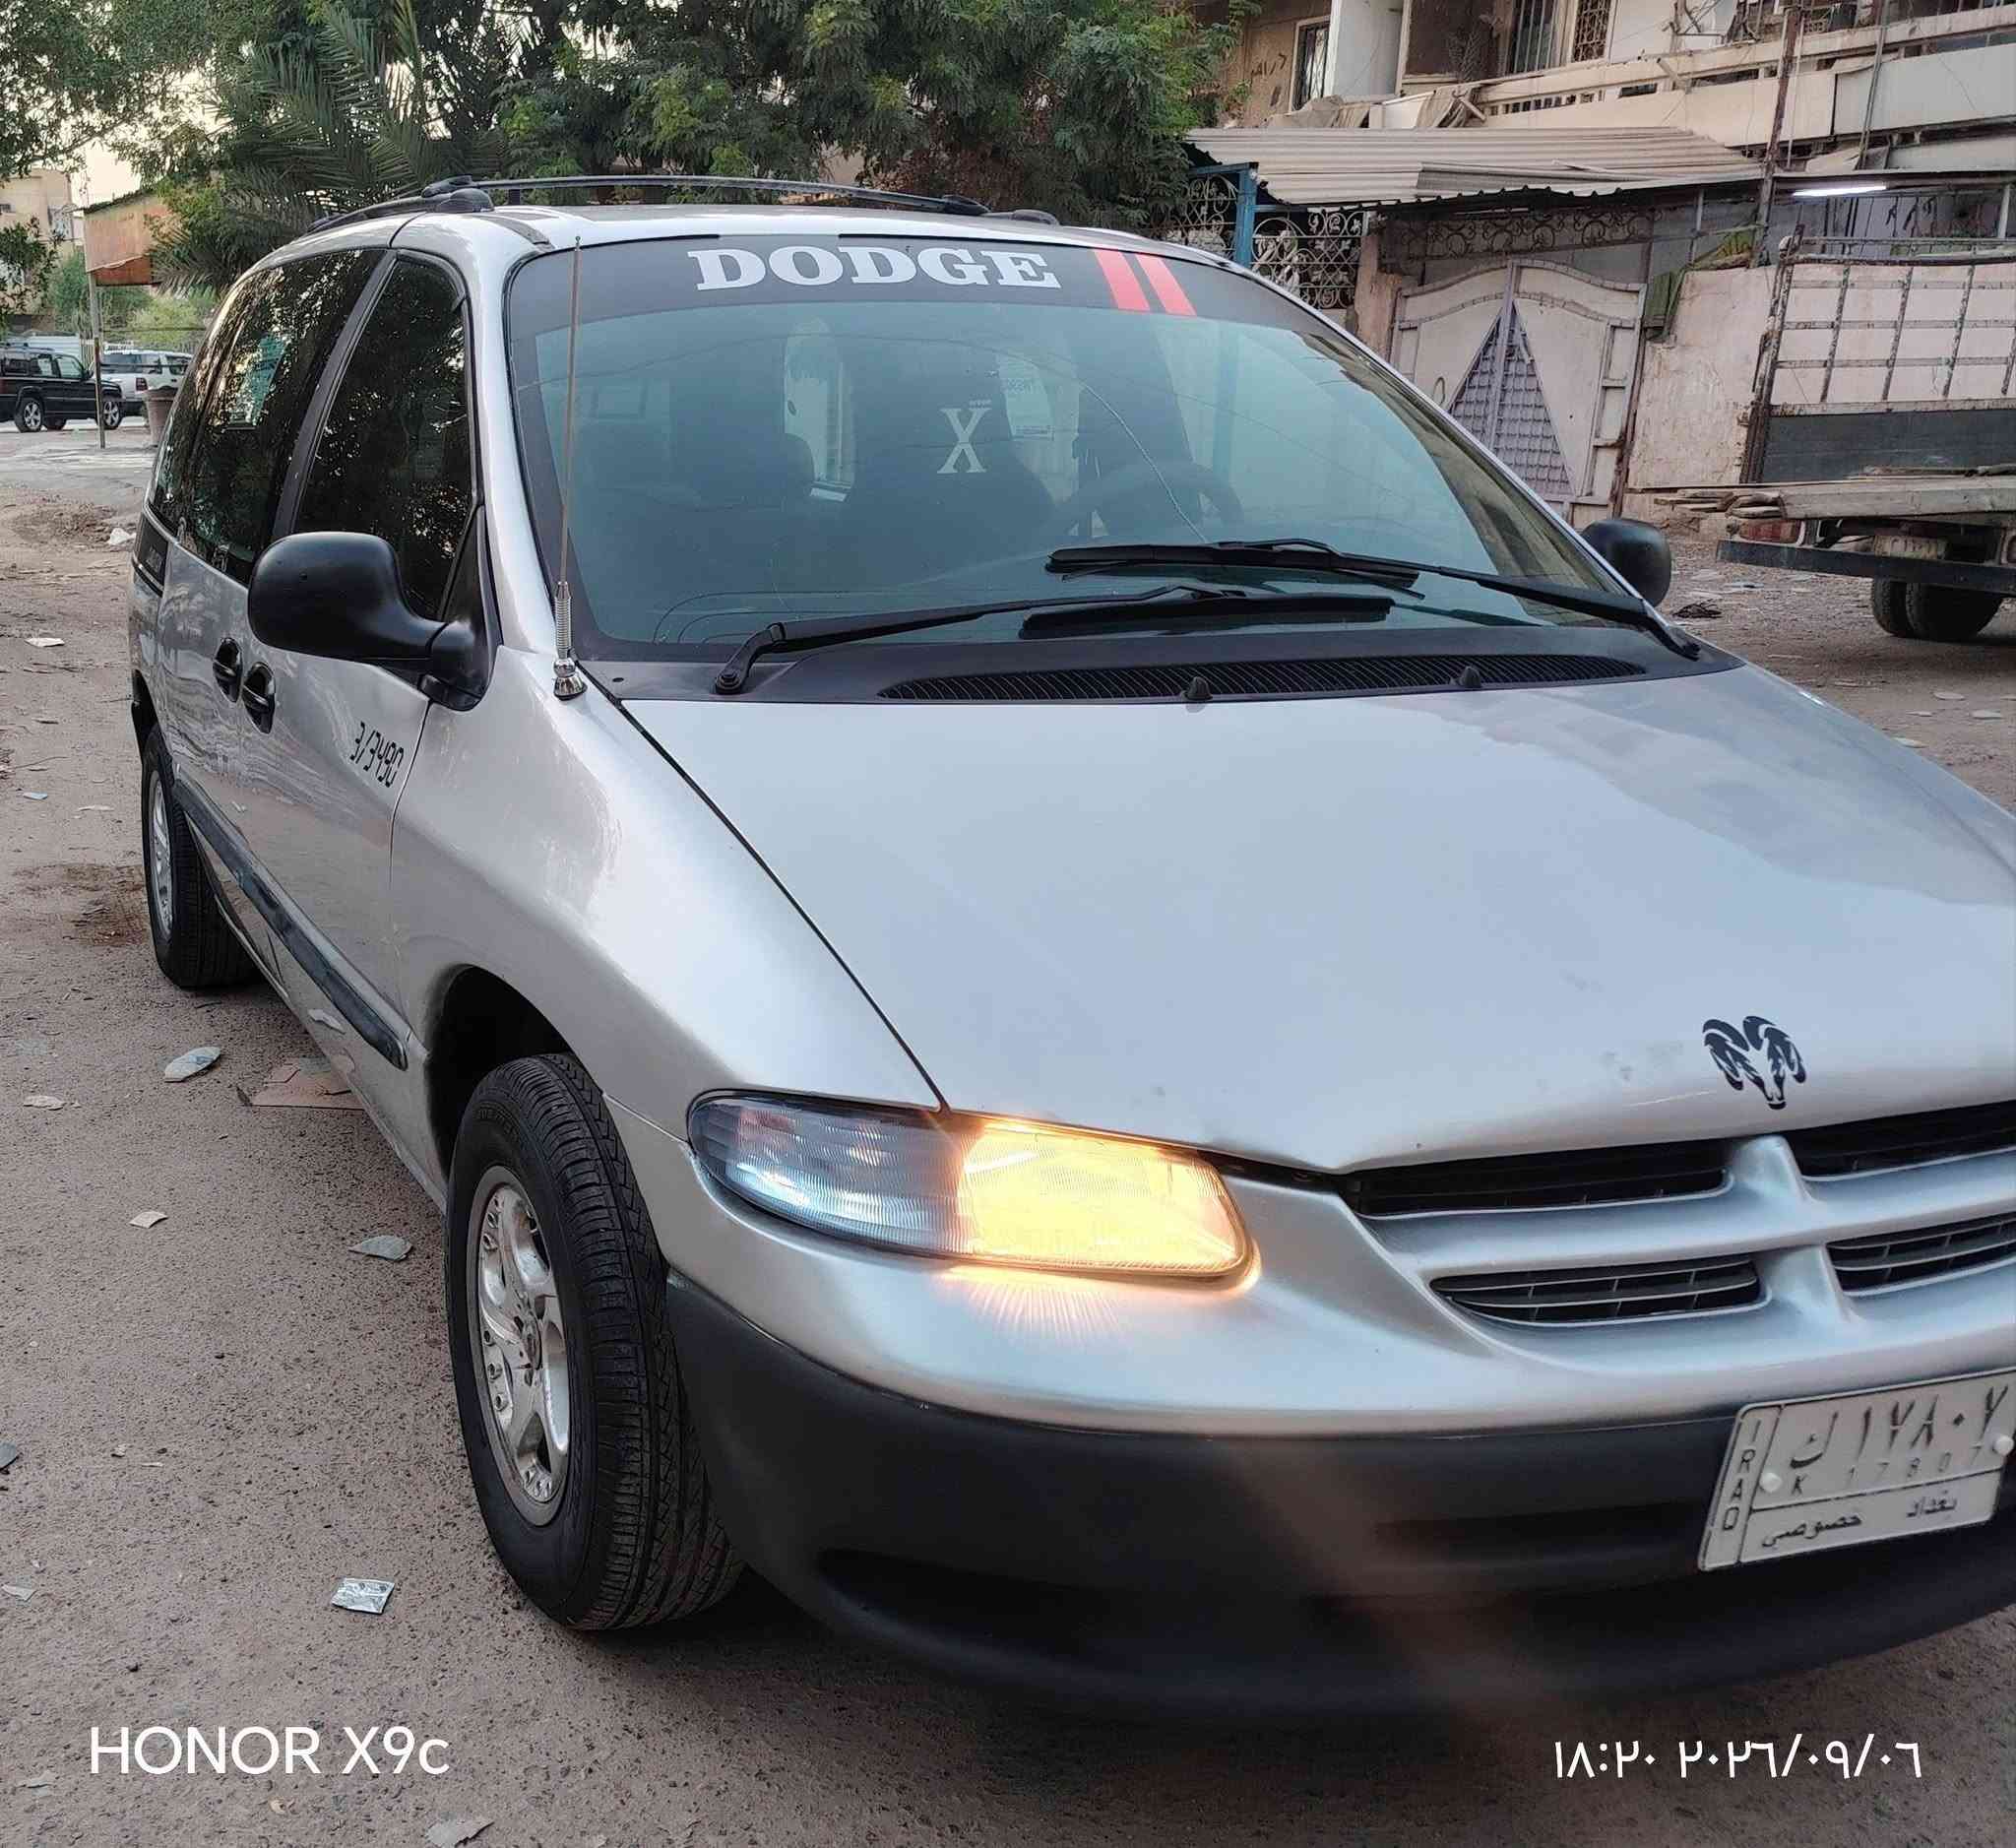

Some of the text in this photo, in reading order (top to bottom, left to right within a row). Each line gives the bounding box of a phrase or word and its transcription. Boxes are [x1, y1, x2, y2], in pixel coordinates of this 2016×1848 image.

[687, 246, 1061, 290] DODGE
[937, 408, 991, 474] X
[1857, 1385, 2009, 1459] ١٧٨٠٧
[1722, 1421, 1762, 1531] IRAQ
[1792, 1474, 1811, 1496] K
[1762, 1489, 1957, 1548] بغداد خصوصي
